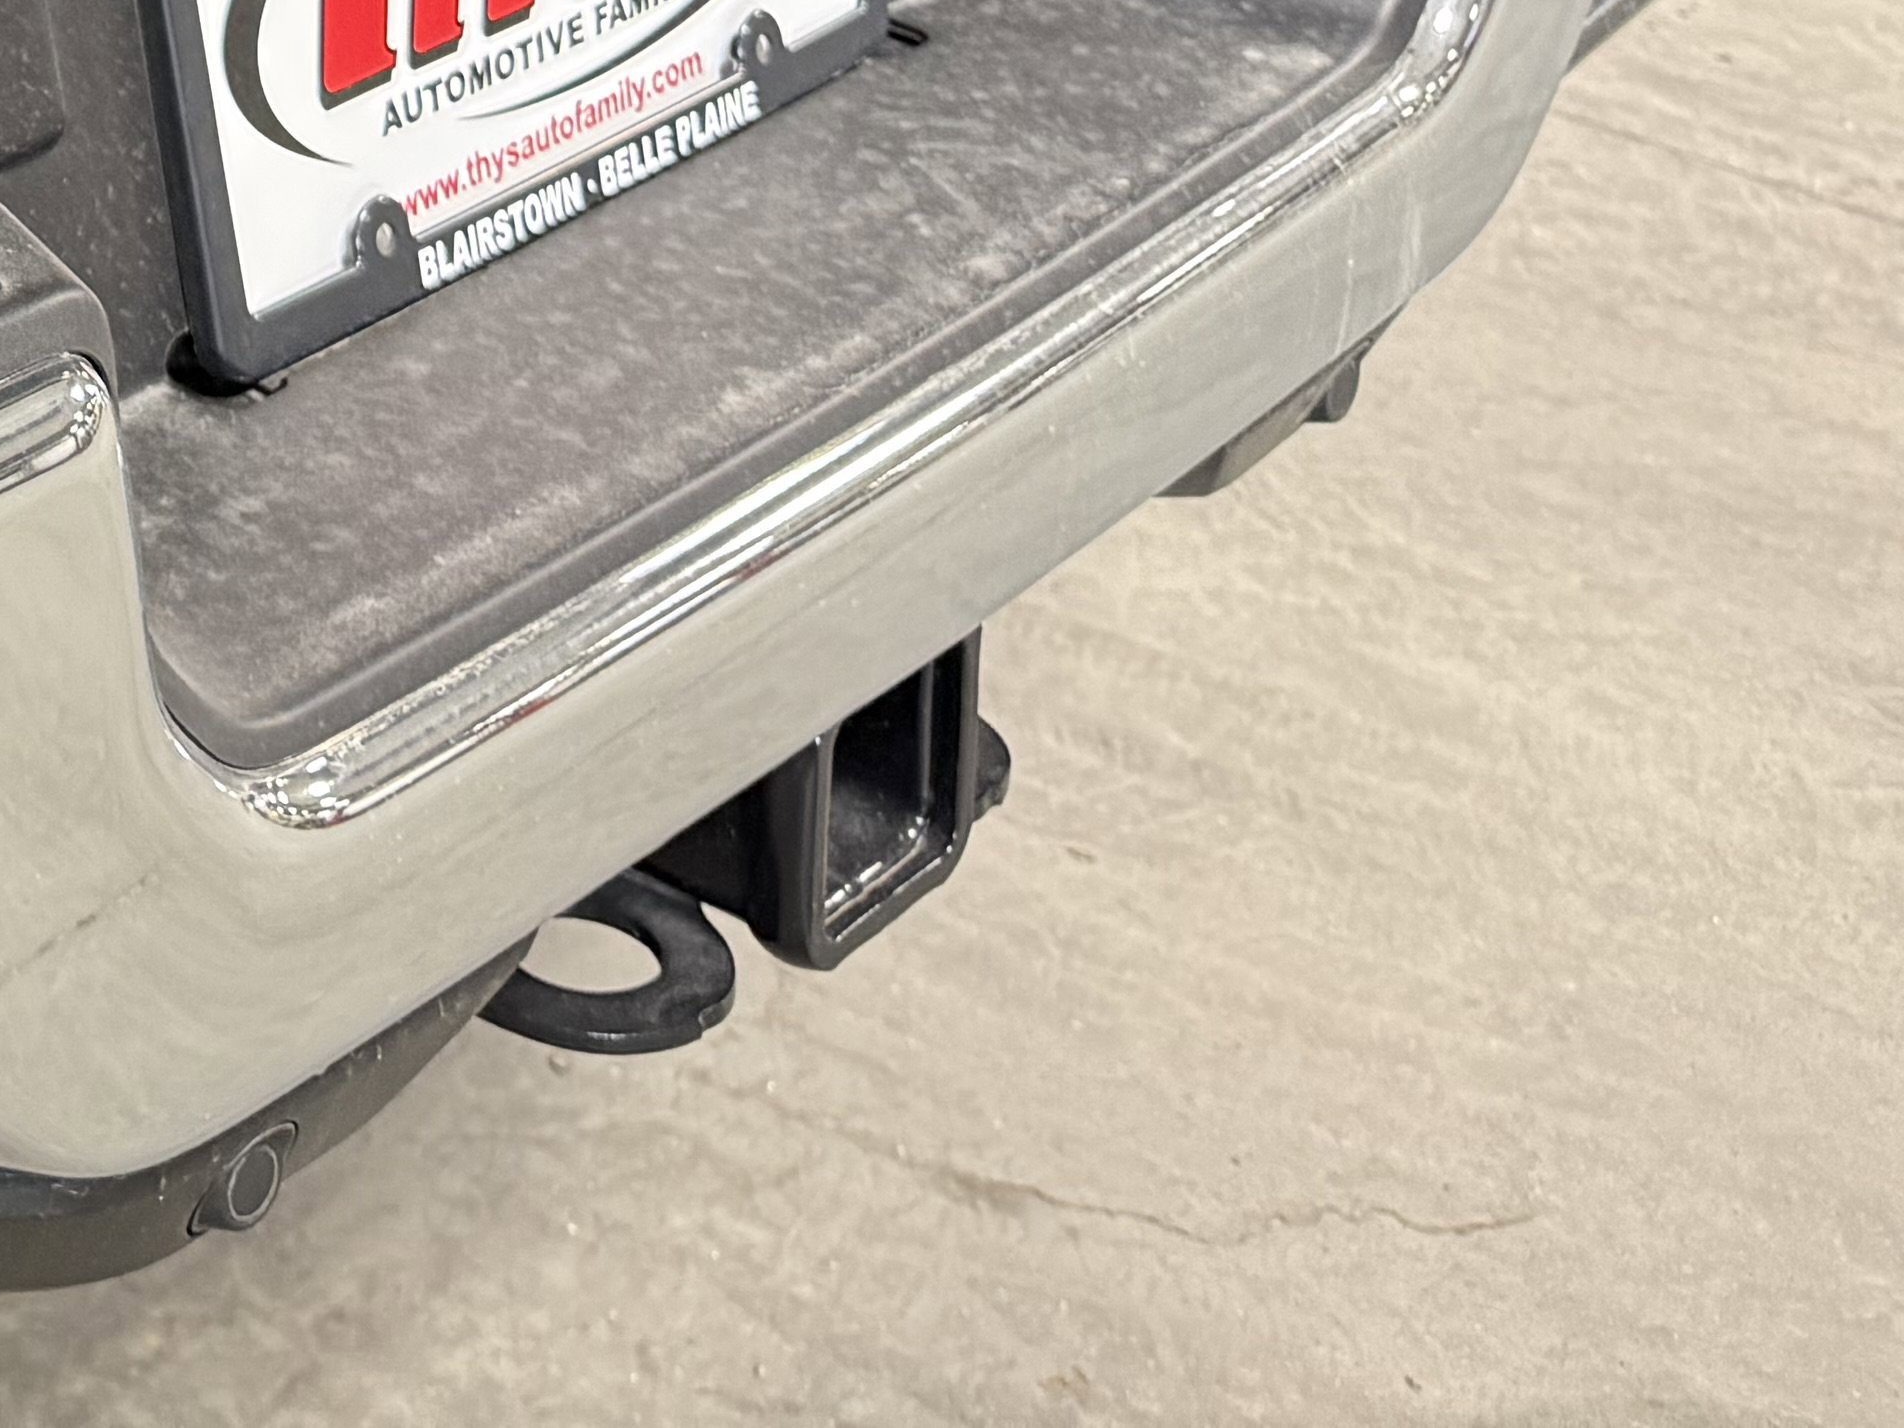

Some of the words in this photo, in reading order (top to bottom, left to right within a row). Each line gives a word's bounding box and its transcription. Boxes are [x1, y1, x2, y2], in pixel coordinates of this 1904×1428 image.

[381, 12, 586, 137] AUTOMOTIVE
[400, 50, 704, 216] www.thysautofamily.com
[417, 171, 585, 291] BLAIRSTOWN
[597, 128, 678, 196] BELLE
[676, 80, 760, 156] PLAINE
